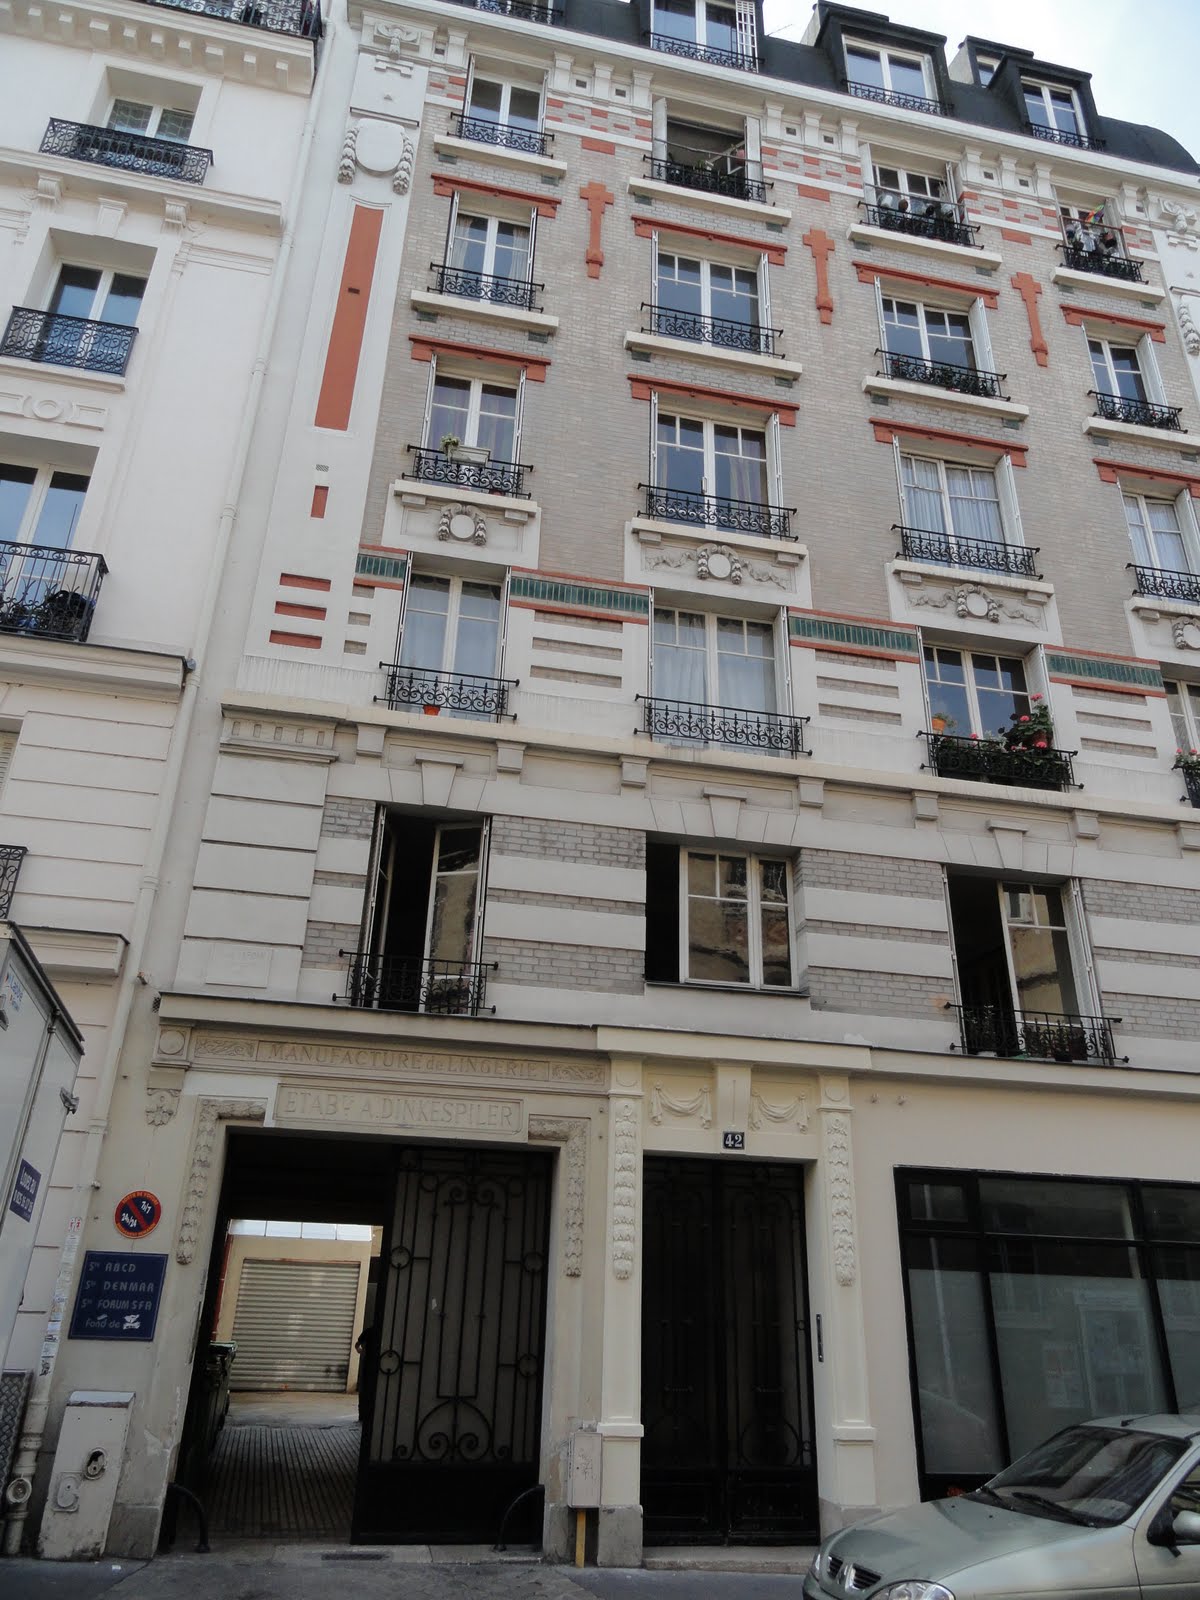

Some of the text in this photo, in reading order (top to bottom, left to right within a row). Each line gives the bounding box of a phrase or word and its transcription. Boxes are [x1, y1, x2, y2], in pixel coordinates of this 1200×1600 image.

[267, 1043, 421, 1070] MANUFACTURE
[447, 1056, 538, 1078] LINGERIE
[725, 1134, 743, 1148] 42
[105, 1262, 136, 1273] ABCD
[97, 1299, 129, 1310] FORUM
[108, 1319, 121, 1329] de
